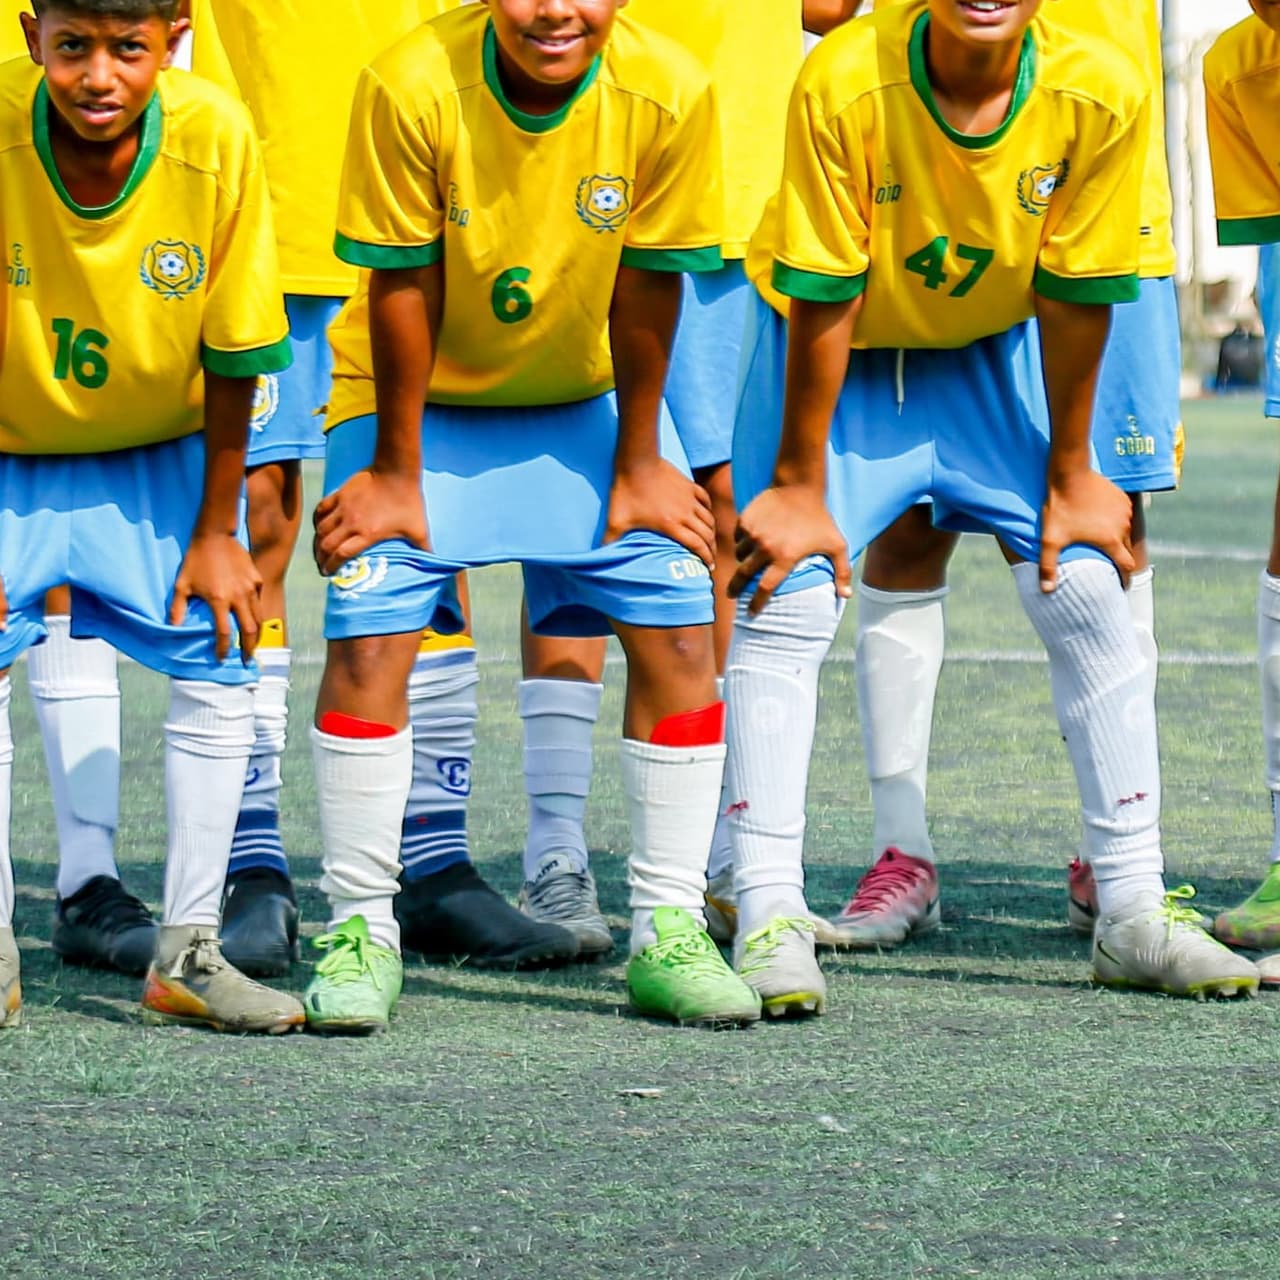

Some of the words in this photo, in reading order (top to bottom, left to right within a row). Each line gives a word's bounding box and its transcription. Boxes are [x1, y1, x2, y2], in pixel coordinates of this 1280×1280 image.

[491, 266, 533, 324] 6
[904, 236, 995, 297] 47
[52, 318, 109, 389] 16
[1115, 436, 1155, 456] COPA
